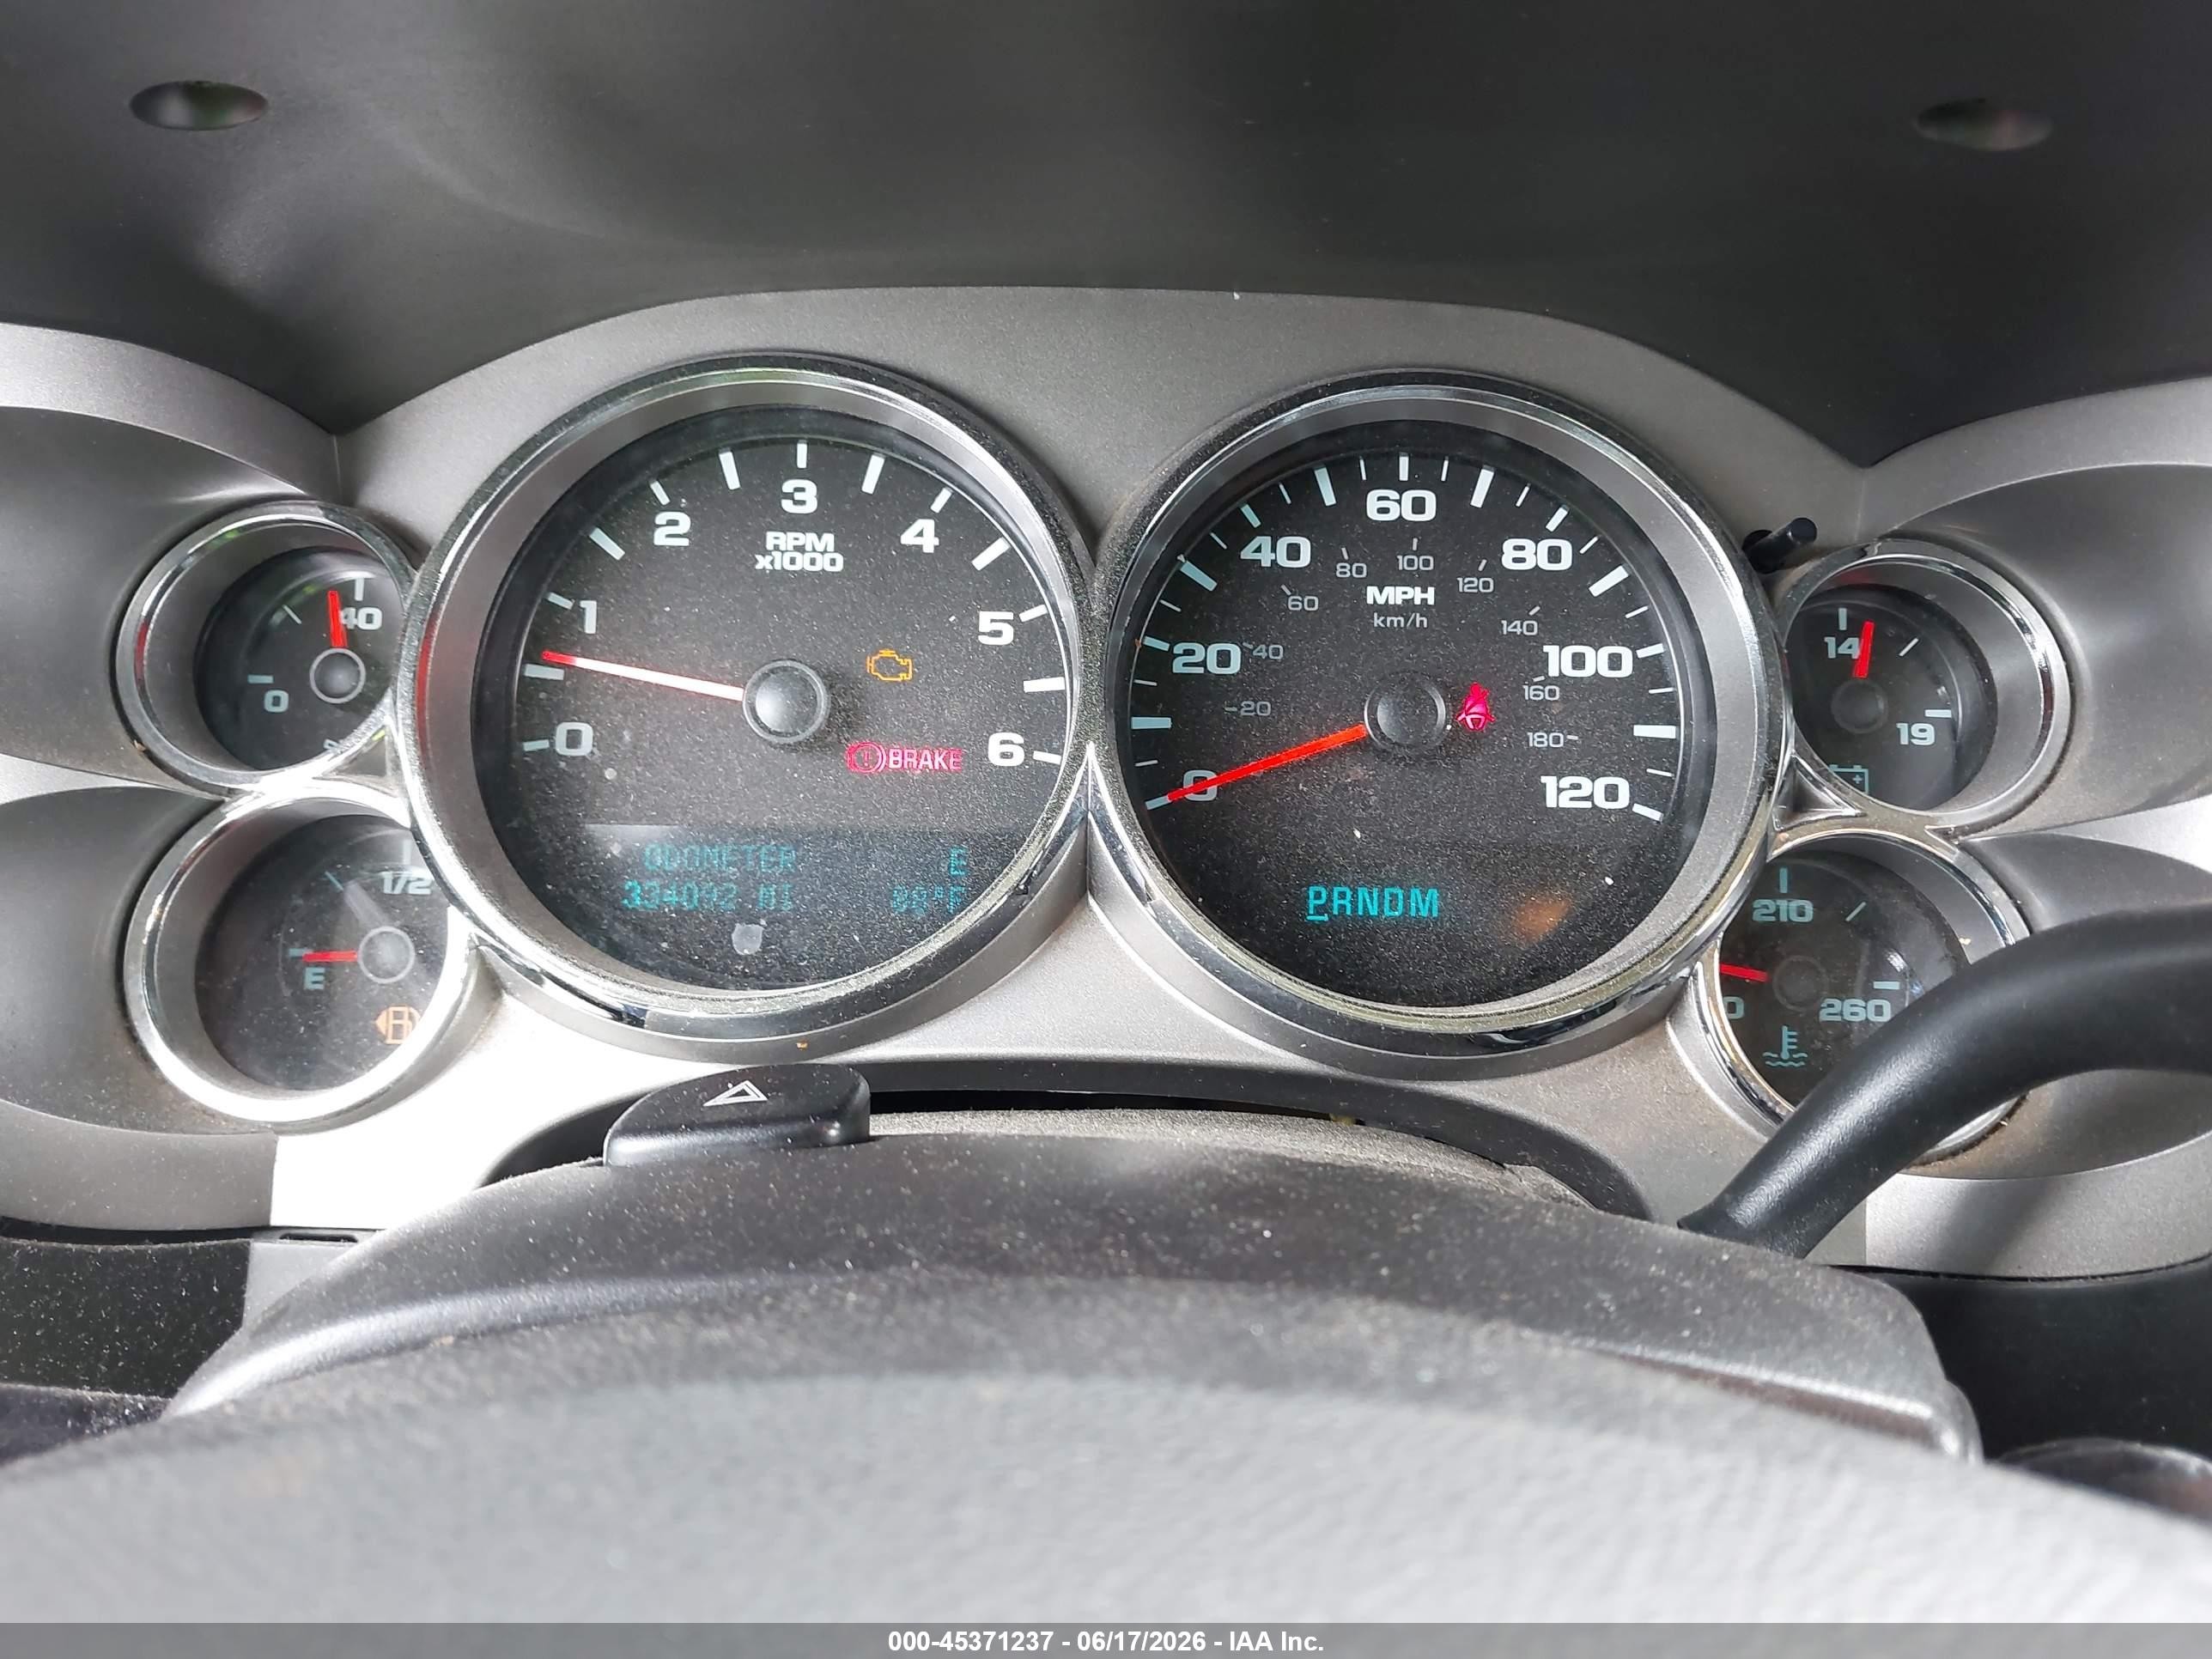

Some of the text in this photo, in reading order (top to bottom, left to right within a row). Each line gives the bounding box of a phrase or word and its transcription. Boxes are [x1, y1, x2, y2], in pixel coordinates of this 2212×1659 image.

[781, 478, 817, 514] 3
[1365, 489, 1437, 521] 60
[653, 511, 691, 547] 2
[900, 518, 939, 553] 4
[765, 532, 835, 551] RPM
[1240, 536, 1311, 568] 40
[755, 551, 844, 572] x1000
[1396, 556, 1434, 571] 100
[1501, 538, 1572, 571] 80
[1335, 562, 1367, 579] 80
[1366, 586, 1435, 605] MPH
[1457, 577, 1494, 593] 120
[1288, 596, 1319, 612] 60
[341, 607, 382, 629] 40
[580, 599, 597, 635] 1
[1374, 611, 1427, 629] km/h
[1501, 619, 1538, 636] 140
[978, 611, 1015, 646] 5
[1172, 642, 1241, 675] 20
[1252, 643, 1284, 660] 40
[1824, 637, 1861, 659] 14
[1543, 645, 1632, 678] 100
[264, 690, 289, 713] 0
[1522, 684, 1560, 702] 160
[1240, 701, 1271, 717] 20
[555, 721, 594, 757] 0
[1527, 732, 1564, 748] 180
[1896, 723, 1935, 745] 19
[888, 748, 962, 770] BRAKE
[988, 732, 1025, 768] 6
[1182, 769, 1218, 802] 0
[1540, 775, 1630, 810] 120
[1307, 885, 1438, 921] PRNDM
[1753, 899, 1814, 923] 210
[305, 967, 325, 989] E
[1820, 999, 1891, 1022] 260
